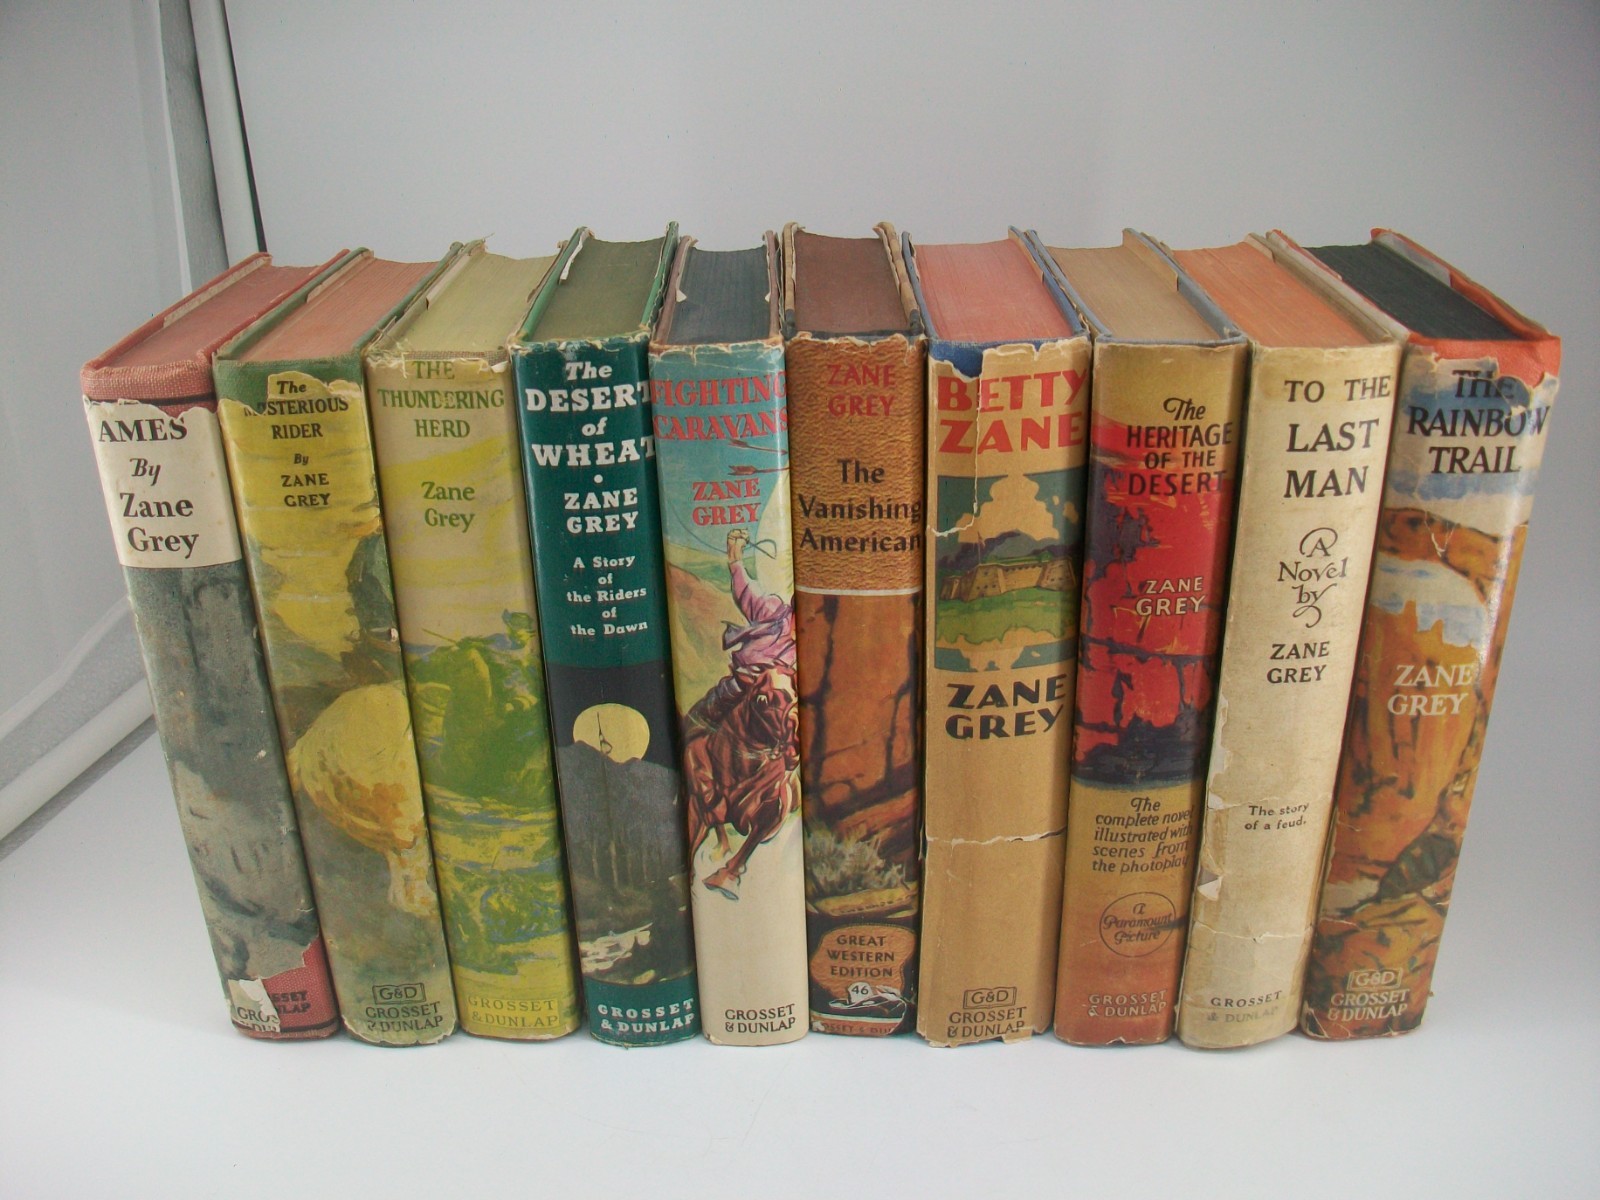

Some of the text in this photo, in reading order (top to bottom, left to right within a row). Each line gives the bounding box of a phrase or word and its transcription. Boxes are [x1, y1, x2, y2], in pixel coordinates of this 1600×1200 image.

[412, 360, 454, 380] THE
[566, 362, 612, 381] The
[828, 364, 895, 386] ZANE
[277, 381, 306, 394] The
[525, 380, 650, 412] DESERT
[650, 370, 786, 406] FIGHTING
[938, 368, 1087, 412] BETTY
[1284, 376, 1391, 402] TO THE
[244, 397, 349, 416] STERIOUS
[377, 389, 504, 409] THUNDERING
[828, 395, 897, 417] GREY
[1163, 398, 1206, 421] The
[98, 417, 187, 442] AMES
[415, 419, 470, 438] HERD
[582, 417, 608, 436] of
[654, 407, 788, 440] CARAVANS
[1407, 405, 1550, 436] RAINBOW
[272, 423, 323, 440] RIDER
[938, 412, 1082, 454] ZANE
[1127, 422, 1232, 448] HERITAGE
[1286, 418, 1379, 452] LAST
[294, 454, 308, 465] By
[532, 436, 655, 466] WHEAT
[1144, 450, 1216, 470] OF THE
[1429, 446, 1522, 474] TRAIL
[129, 458, 161, 486] By
[281, 474, 329, 487] ZANE
[838, 458, 884, 484] The
[421, 482, 474, 500] Zane
[692, 478, 760, 501] ZANE
[1128, 470, 1226, 496] DESERT
[1284, 466, 1368, 498] MAN
[120, 492, 193, 517] Zane
[284, 493, 330, 507] GREY
[564, 488, 638, 510] ZANE
[692, 502, 761, 526] GREY
[798, 494, 921, 524] Vanishing
[424, 508, 475, 533] Grey
[566, 512, 638, 533] GREY
[128, 527, 199, 558] Grey
[800, 528, 920, 552] American
[1300, 527, 1338, 557] A
[573, 556, 636, 568] A Story
[1278, 557, 1348, 582] Novel
[598, 573, 613, 584] of
[1146, 577, 1204, 594] ZANE
[566, 588, 646, 602] the Riders
[602, 607, 616, 618] of
[1136, 594, 1206, 616] GREY
[1291, 583, 1338, 628] by
[570, 622, 648, 636] the Dawn
[1270, 642, 1330, 660] ZANE
[1267, 665, 1327, 684] GREY
[1394, 664, 1476, 688] ZANE
[946, 674, 1067, 710] ZANE
[1387, 692, 1468, 716] GREY
[946, 704, 1064, 740] GREY
[1130, 797, 1160, 812] The
[1248, 803, 1310, 816] The story
[1096, 805, 1194, 829] complete novel
[1244, 816, 1306, 830] of a feud.
[1094, 821, 1193, 842] illustrated with
[1092, 840, 1189, 859] scenes from
[1092, 855, 1190, 874] the photoplay
[1103, 912, 1172, 930] Paramount
[836, 935, 886, 946] GREAT
[1114, 930, 1160, 945] Picture
[827, 950, 894, 962] WESTERN
[830, 966, 893, 978] EDITION
[1356, 972, 1394, 986] G&D
[380, 986, 417, 1000] G&D
[852, 985, 870, 995] 46
[972, 990, 1008, 1004] G&D
[1088, 990, 1168, 1005] GROSSET
[1211, 990, 1282, 1008] GROSSET
[1330, 989, 1410, 1006] GROSSET
[366, 1001, 440, 1018] GROSSET
[468, 996, 555, 1011] GROSSET
[598, 998, 694, 1018] GROSSET
[725, 1003, 795, 1021] GROSSET
[1105, 1002, 1167, 1018] DUNLAP
[1342, 1004, 1408, 1022] DUNLAP
[602, 1013, 694, 1033] & DUNLAP
[949, 1006, 1027, 1024] GROSSET
[1225, 1006, 1278, 1022] DUNLAP
[380, 1016, 443, 1032] DUNLAP
[738, 1017, 796, 1034] DUNLAP
[962, 1020, 1025, 1038] DUNLAP
